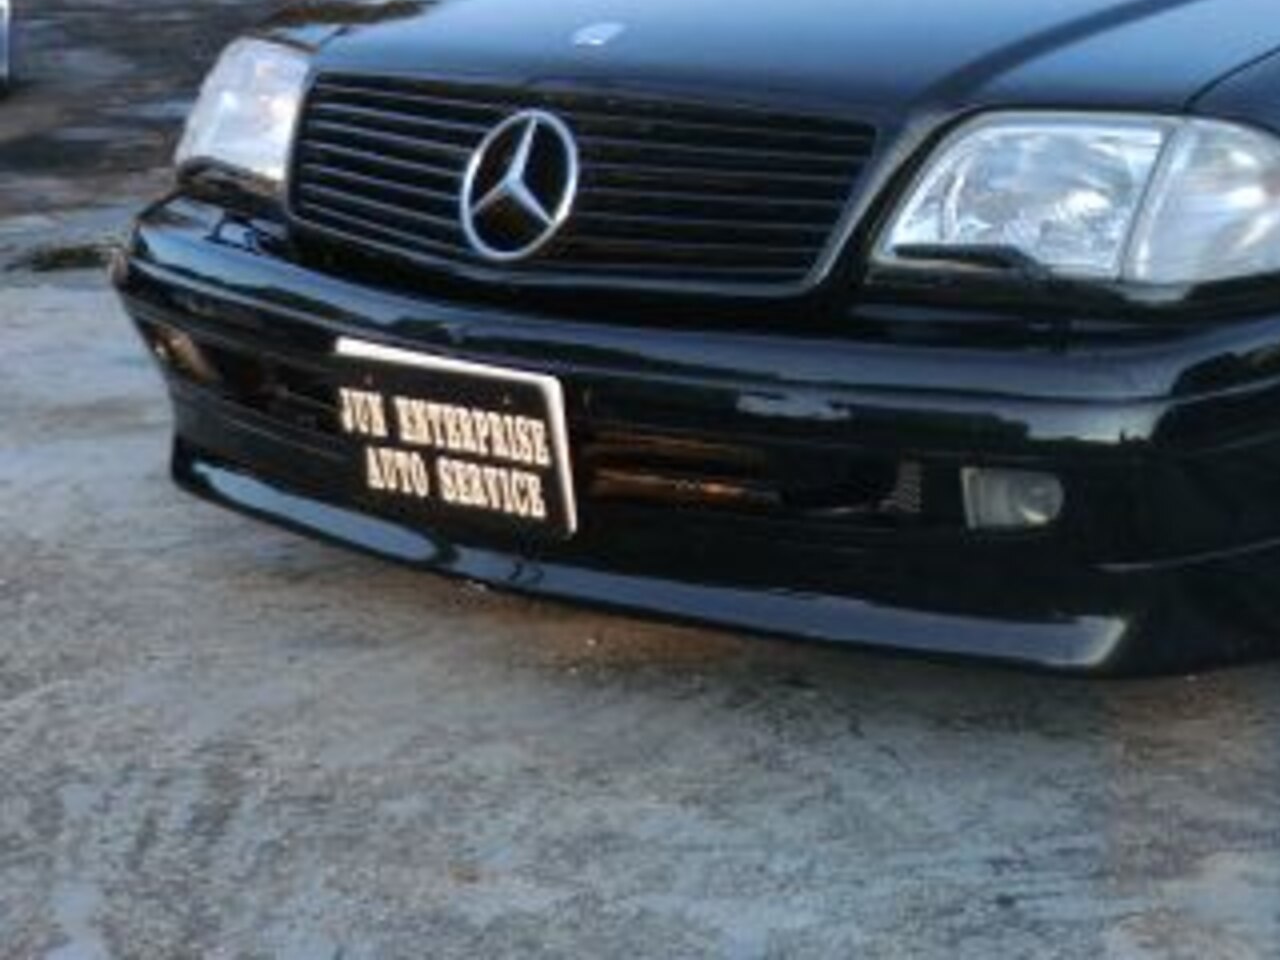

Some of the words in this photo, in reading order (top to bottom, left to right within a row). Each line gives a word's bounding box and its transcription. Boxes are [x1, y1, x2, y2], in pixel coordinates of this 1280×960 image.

[340, 388, 388, 436] JUN
[394, 396, 550, 465] ENTERPRISE
[366, 447, 429, 497] AUTO
[436, 457, 546, 518] SERVICE
